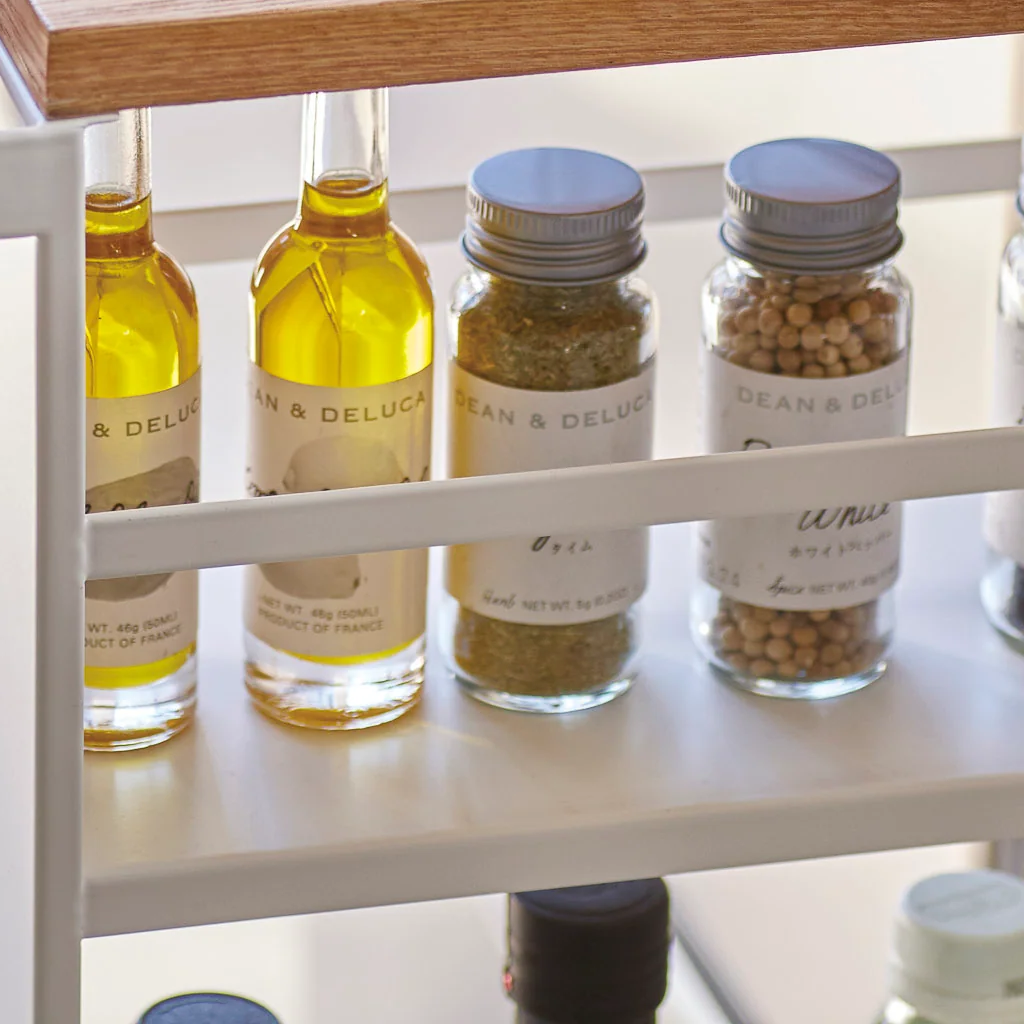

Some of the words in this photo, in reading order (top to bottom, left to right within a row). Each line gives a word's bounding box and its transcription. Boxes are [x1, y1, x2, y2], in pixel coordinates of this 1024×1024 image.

[290, 402, 307, 420] &
[321, 390, 426, 424] DELUCA
[736, 384, 815, 414] DEAN
[825, 396, 842, 414] &
[455, 388, 516, 425] DEAN
[529, 412, 547, 430] &
[92, 422, 110, 438] &
[116, 623, 140, 635] 46g
[312, 623, 330, 635] OF
[334, 618, 385, 635] FRANCE
[119, 637, 137, 649] OF
